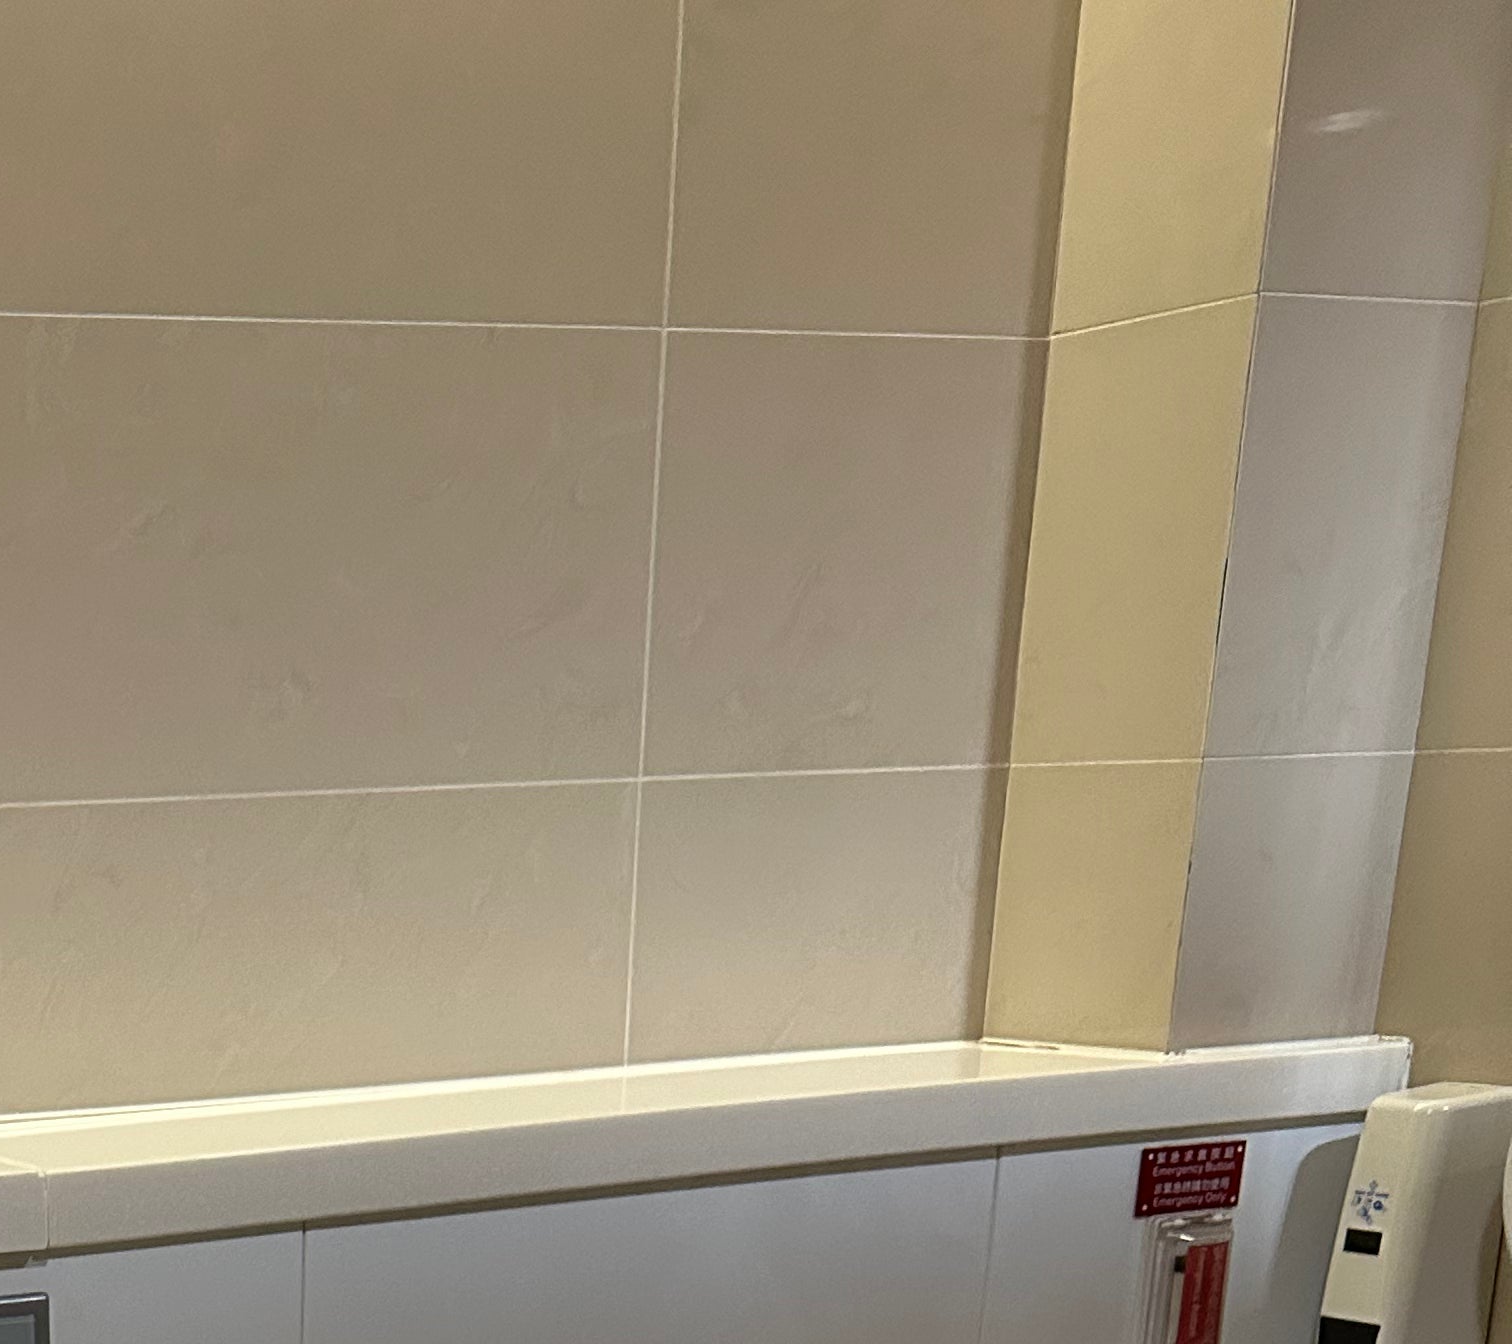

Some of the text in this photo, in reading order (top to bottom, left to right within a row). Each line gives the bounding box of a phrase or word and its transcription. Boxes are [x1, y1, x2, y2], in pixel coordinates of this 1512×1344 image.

[1152, 1161, 1236, 1178] Emergency Button
[1152, 1191, 1228, 1208] Emergency Only
